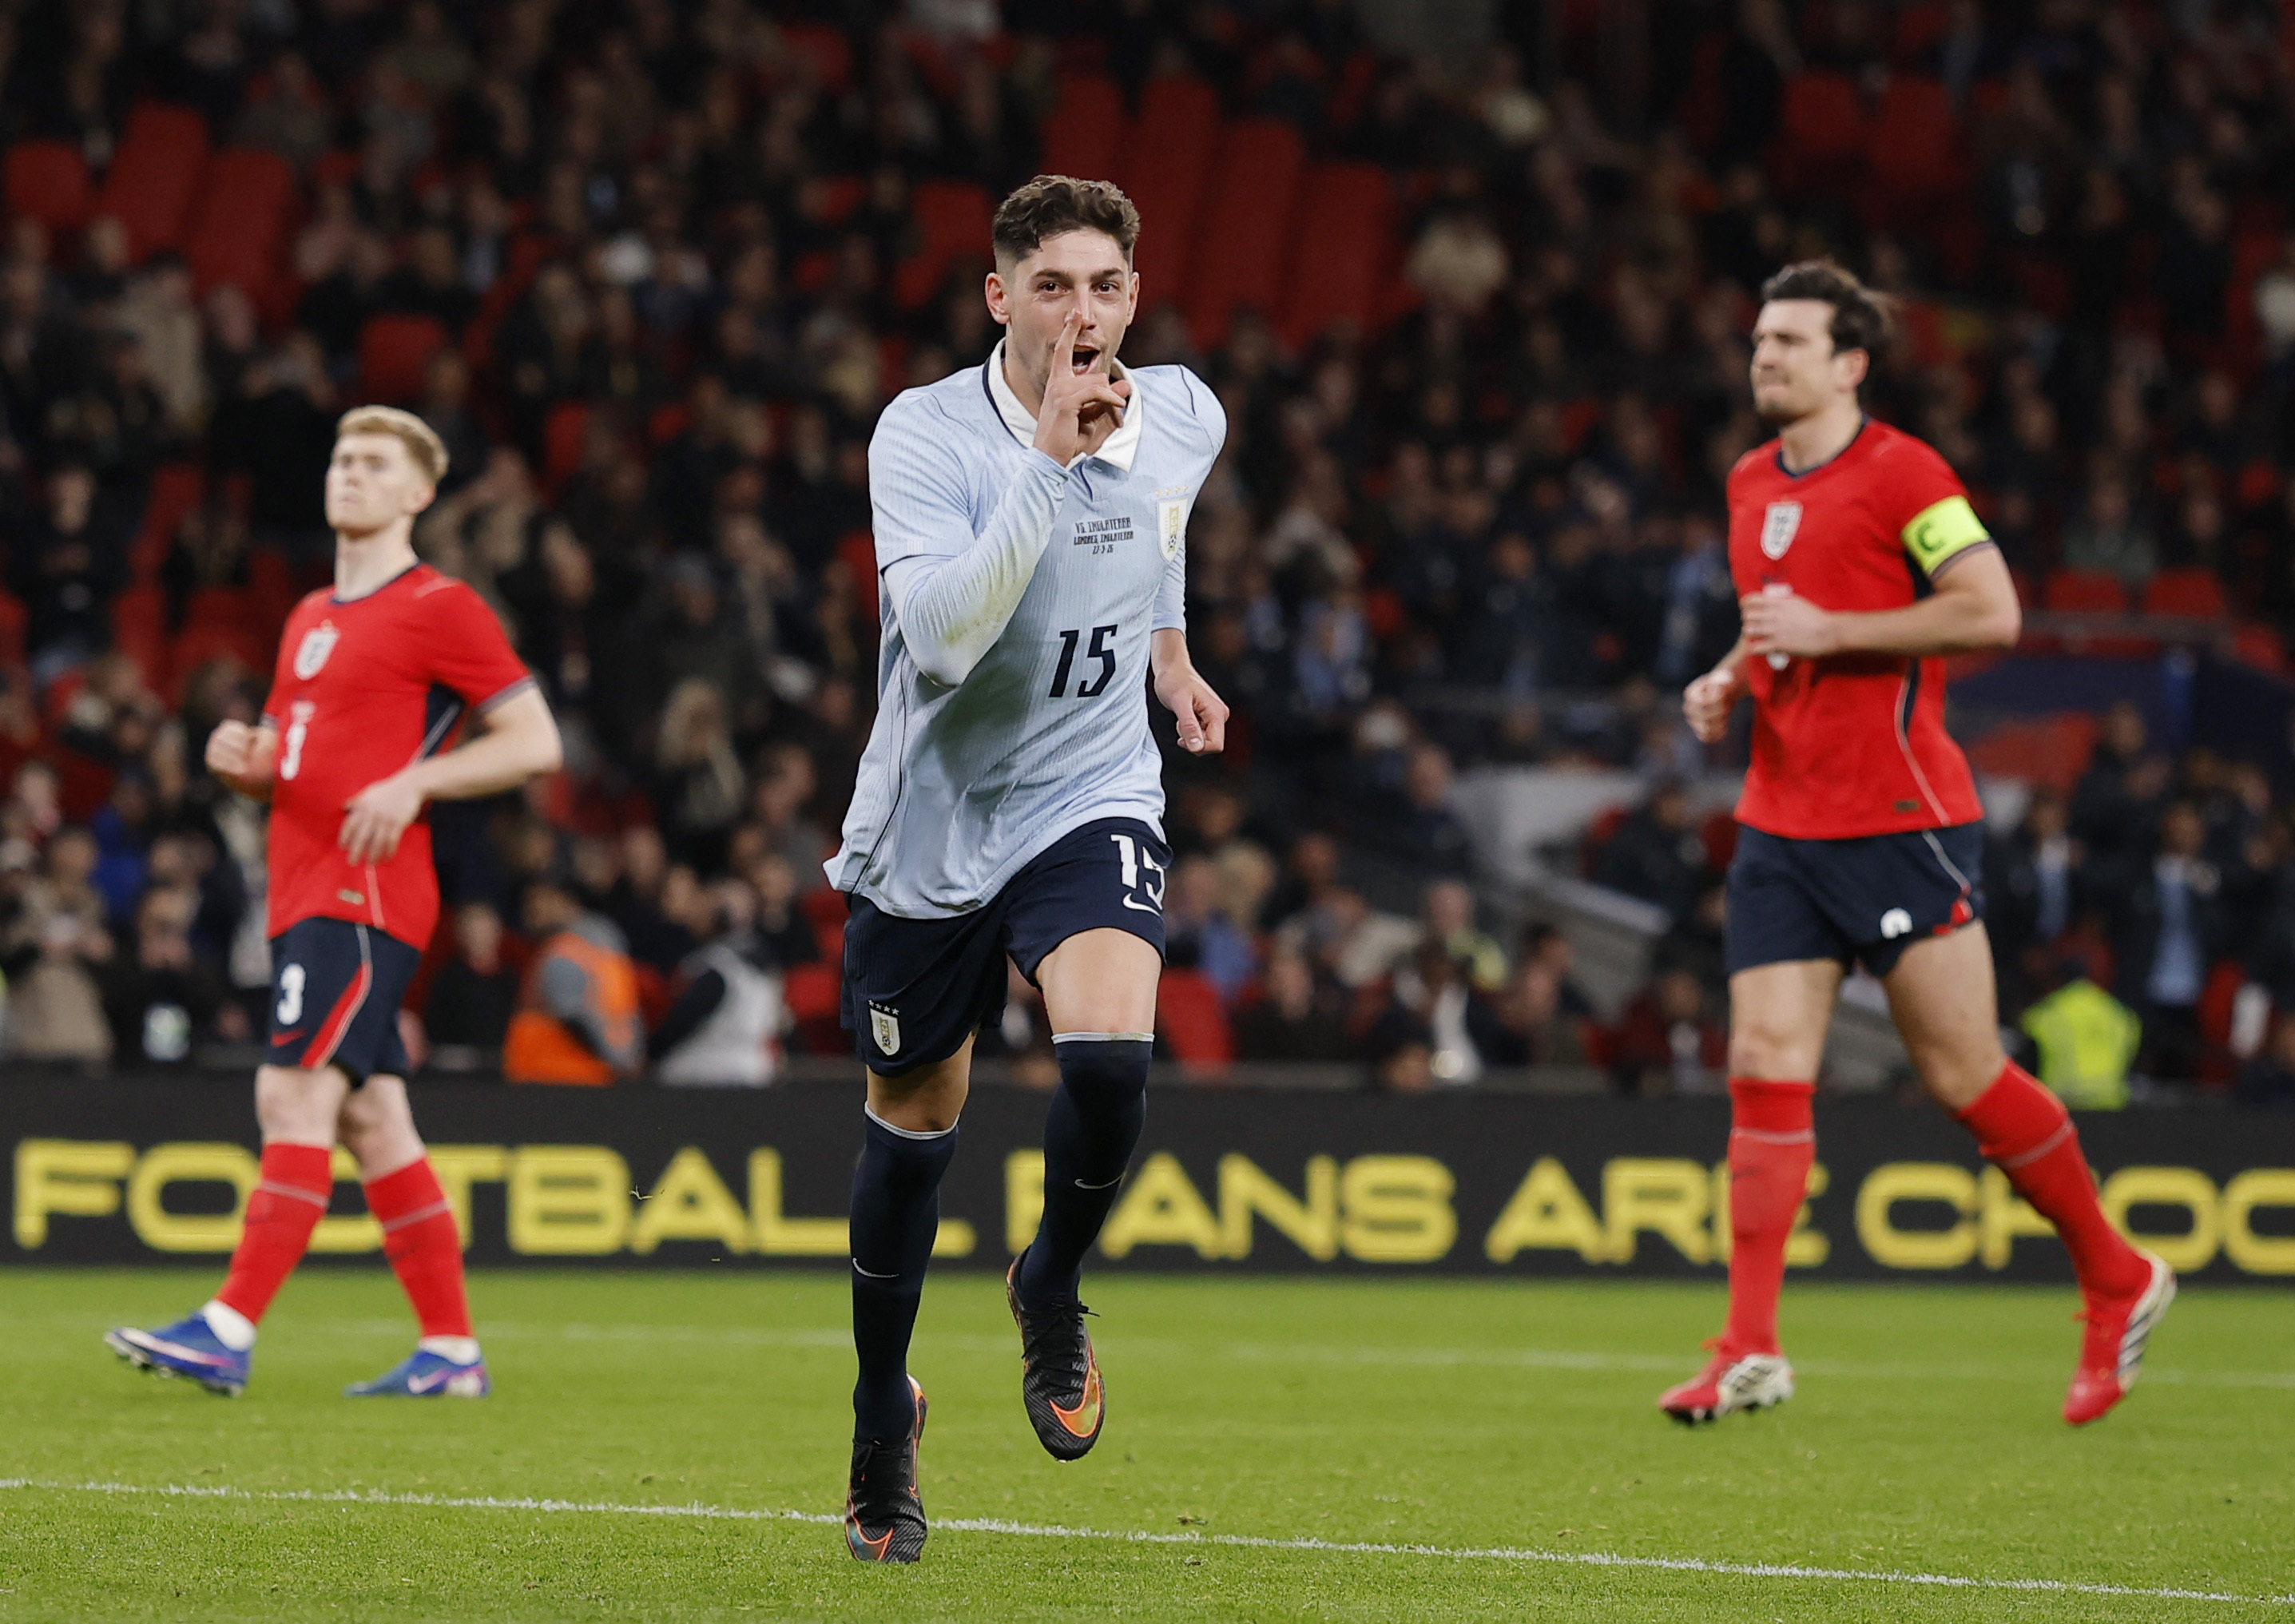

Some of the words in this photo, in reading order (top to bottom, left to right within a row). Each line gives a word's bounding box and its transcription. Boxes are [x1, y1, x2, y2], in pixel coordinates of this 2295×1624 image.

[1918, 523, 1945, 552] C
[1048, 624, 1118, 697] 15
[277, 963, 306, 1025] 3
[13, 1138, 976, 1257] FOTBAL
